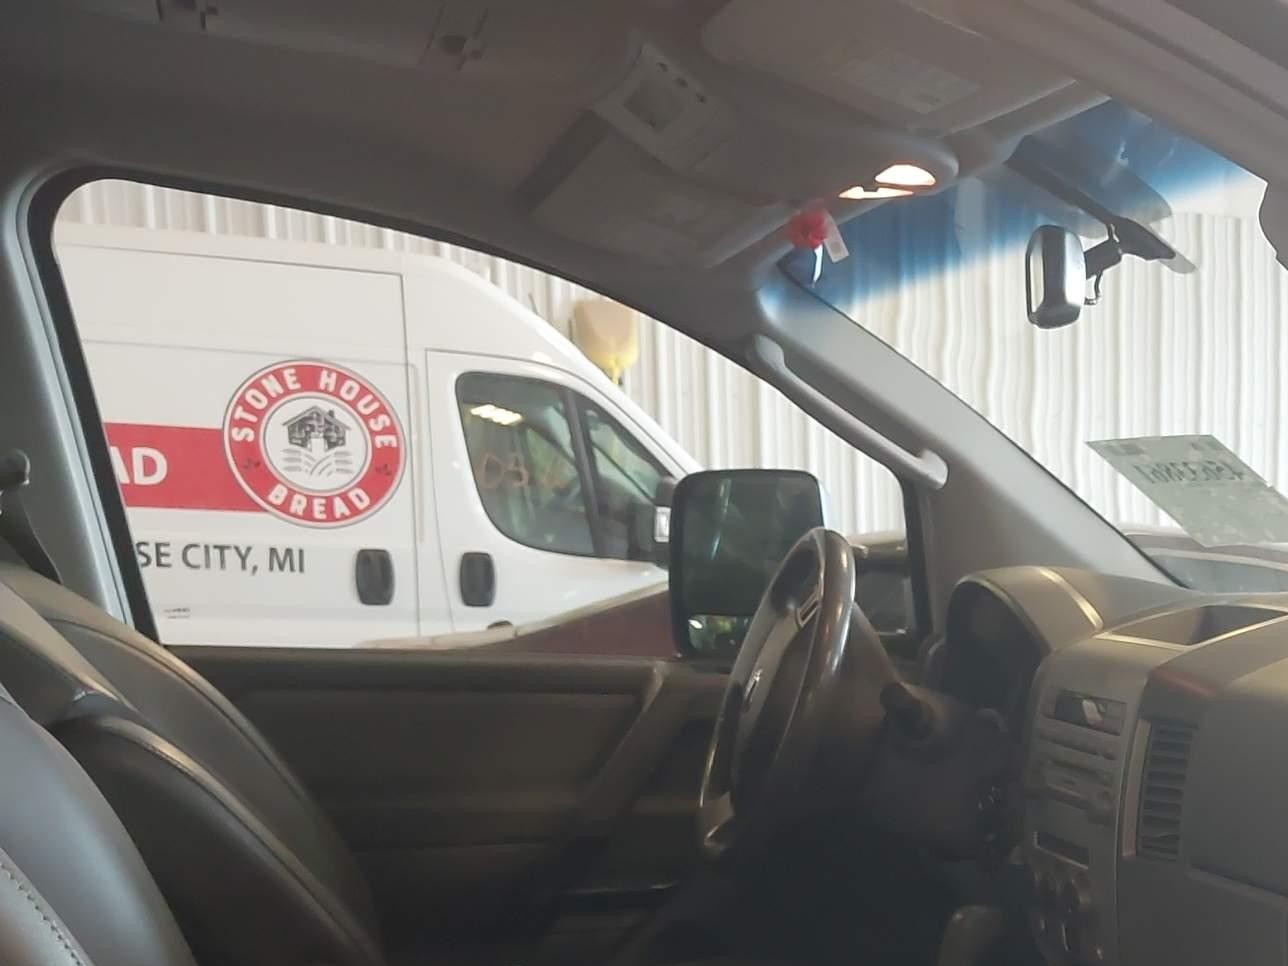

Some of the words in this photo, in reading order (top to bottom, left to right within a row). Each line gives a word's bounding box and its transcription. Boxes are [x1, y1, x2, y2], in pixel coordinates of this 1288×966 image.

[231, 368, 301, 443] STONE
[319, 369, 398, 449] HOUSE
[268, 483, 371, 520] BREAD
[181, 543, 259, 576] CITY,
[268, 546, 306, 574] MI
